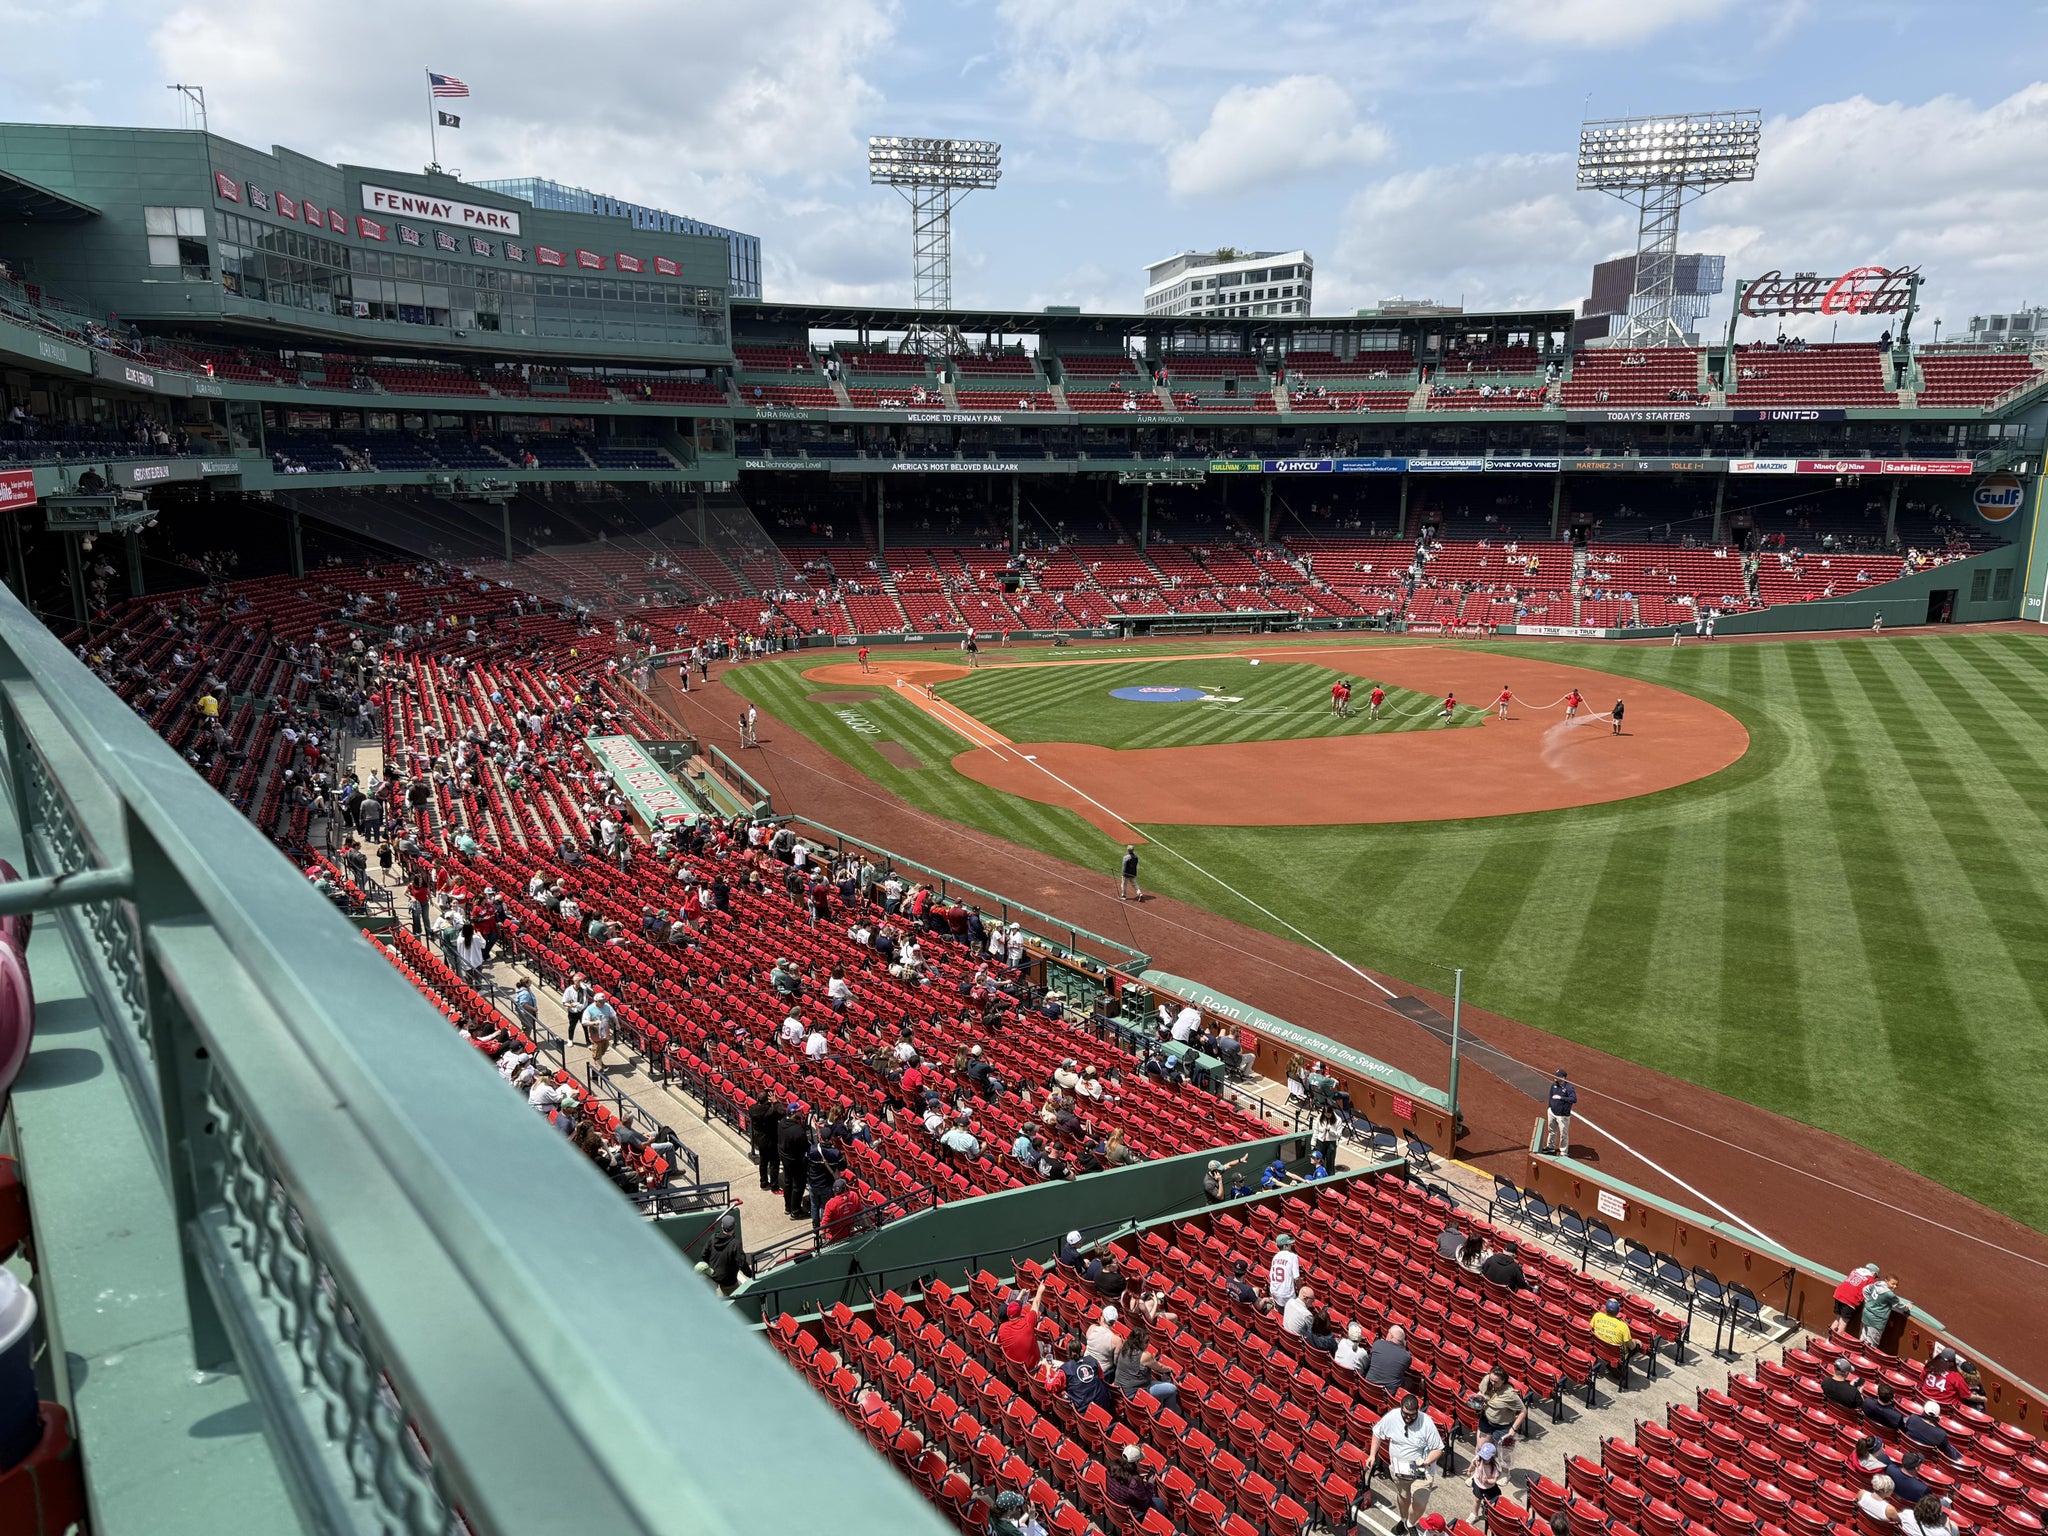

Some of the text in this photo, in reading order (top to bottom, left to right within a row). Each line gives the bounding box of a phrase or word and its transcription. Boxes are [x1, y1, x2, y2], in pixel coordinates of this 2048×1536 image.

[374, 192, 510, 229] FENWAY PARK
[1740, 264, 1922, 317] Coca-Cola
[779, 411, 808, 419] PAVILION
[908, 414, 1002, 422] WELCOME TO FENWAY PARK
[1607, 411, 1690, 420] TODAY'S STARTERS
[1773, 411, 1819, 420] UNITED
[805, 461, 822, 469] Level
[1290, 462, 1317, 470] HYCU
[1814, 463, 1836, 471] Ninety
[1887, 463, 1927, 472] Safelite
[1975, 488, 2019, 505] Gulf
[2028, 598, 2041, 607] 310
[834, 709, 881, 734] WHOOP
[598, 738, 687, 813] BOSTON RED SOX
[1253, 1016, 1394, 1076] Visit us at our store in One Seaport
[1926, 1373, 1947, 1393] 34
